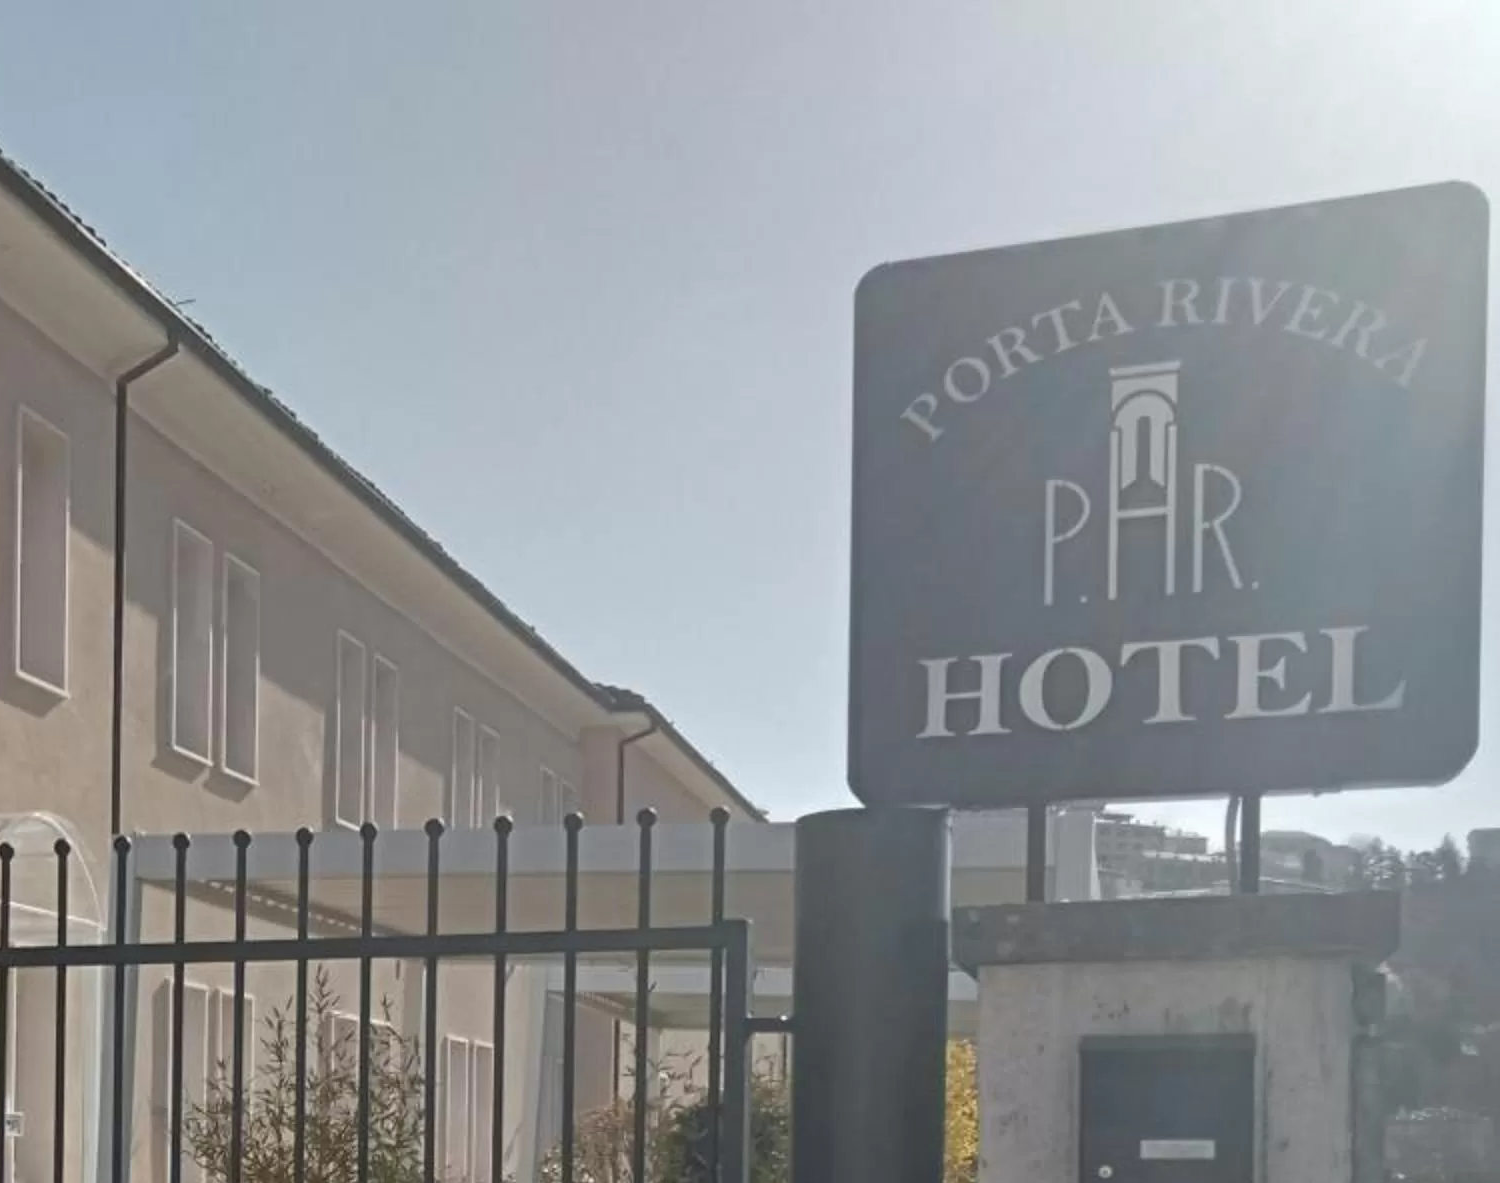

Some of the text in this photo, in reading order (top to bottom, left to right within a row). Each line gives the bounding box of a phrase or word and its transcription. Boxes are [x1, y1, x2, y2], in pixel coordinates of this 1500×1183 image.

[900, 276, 1429, 443] PORTA RIVERA
[915, 624, 1407, 739] HOTEL
